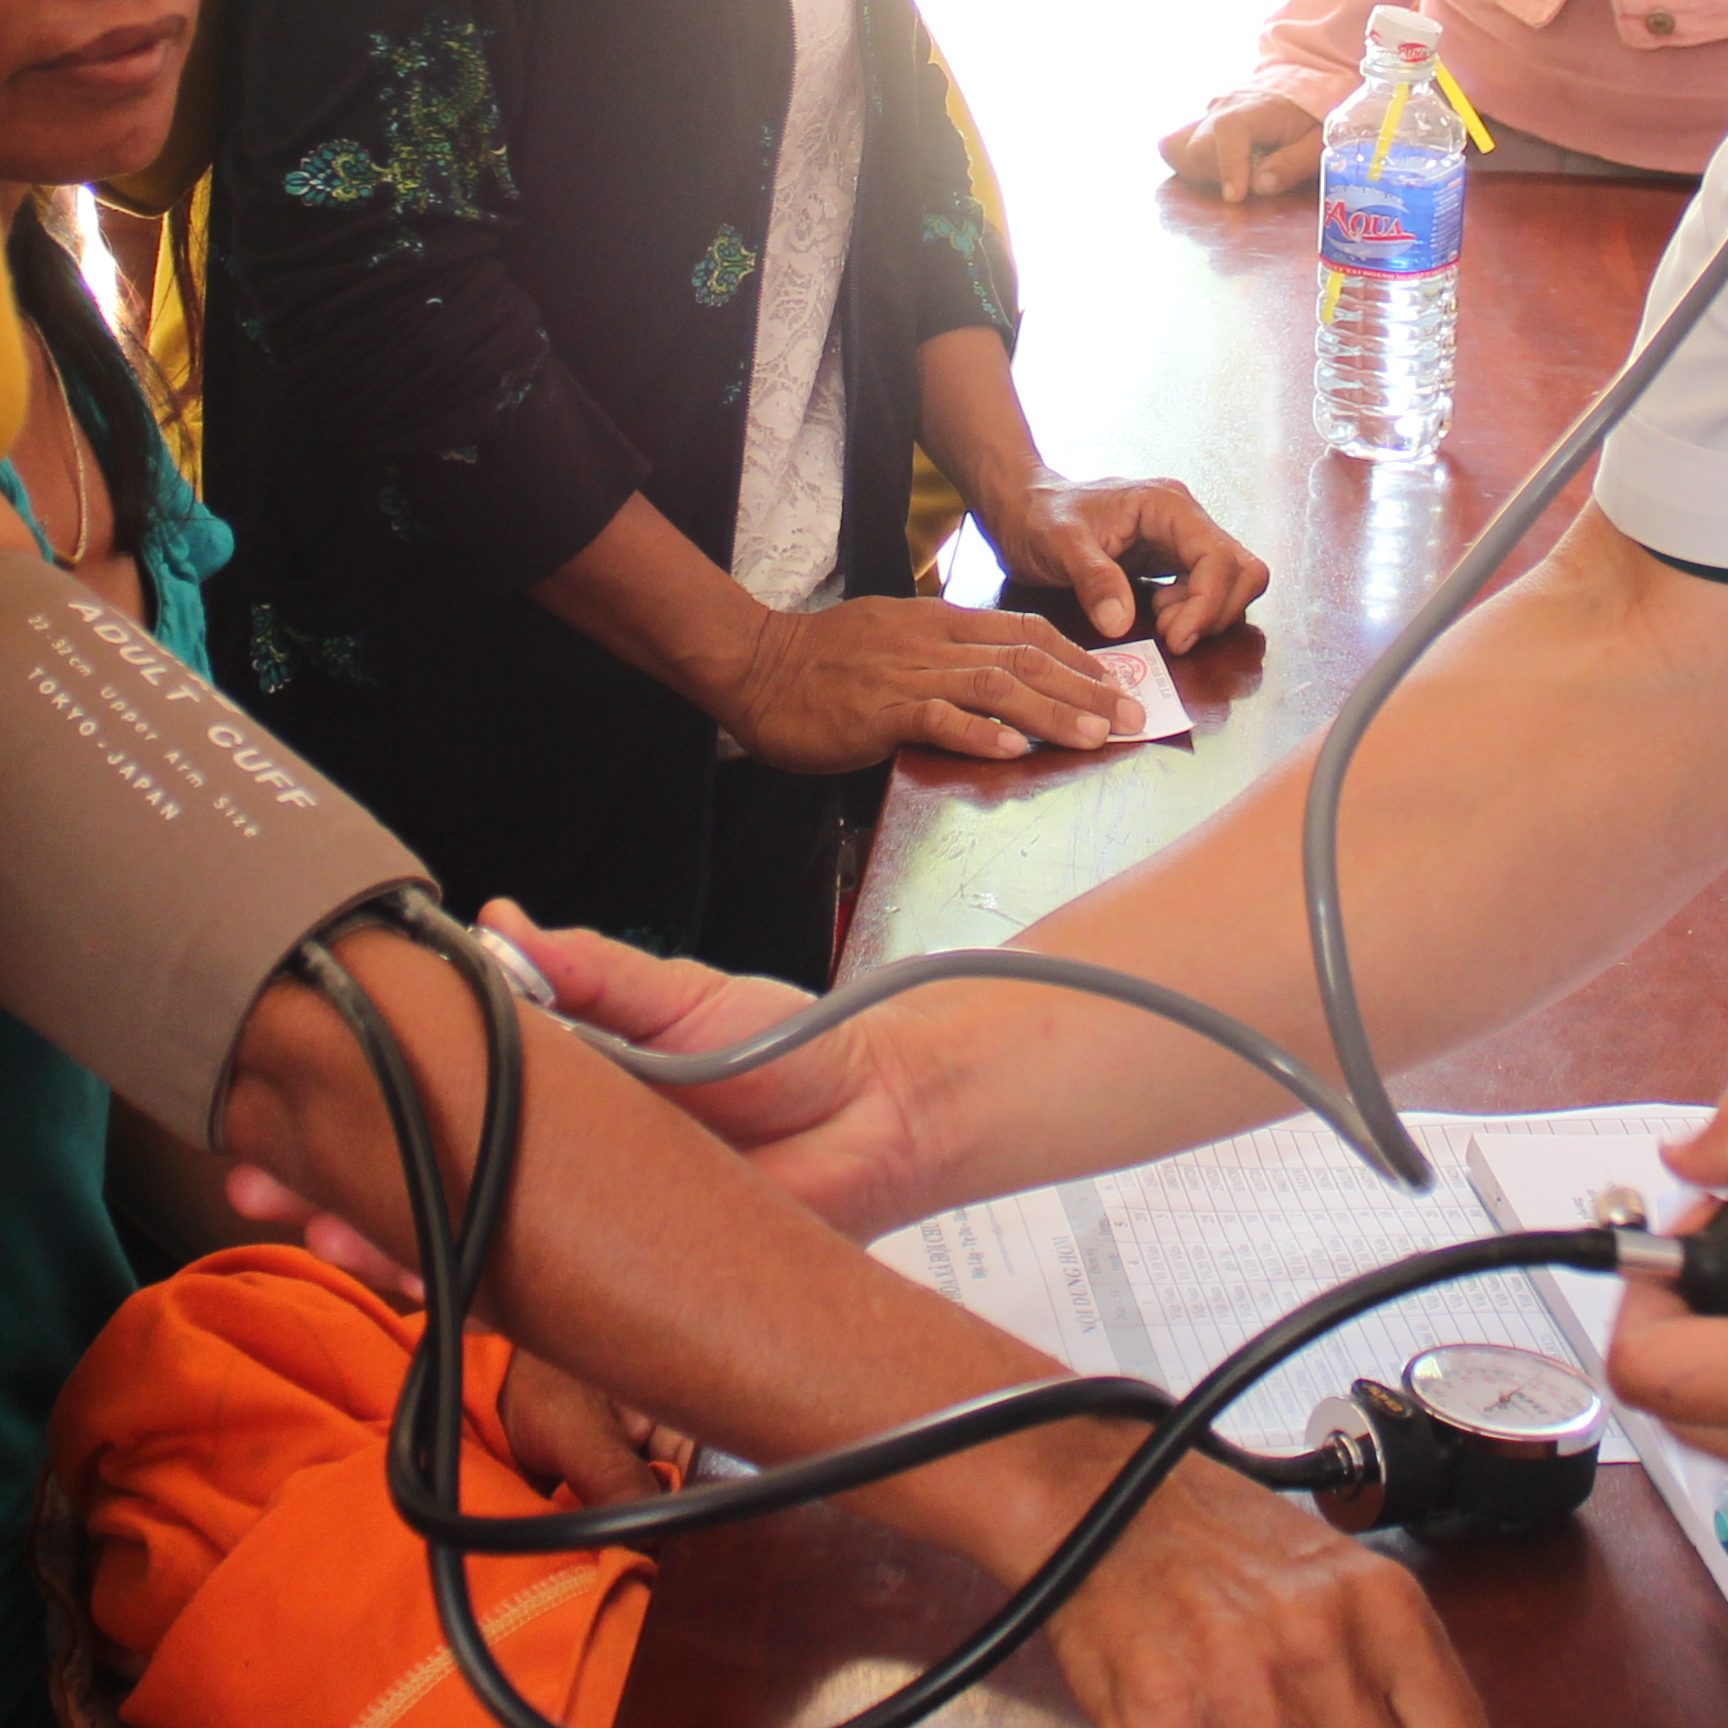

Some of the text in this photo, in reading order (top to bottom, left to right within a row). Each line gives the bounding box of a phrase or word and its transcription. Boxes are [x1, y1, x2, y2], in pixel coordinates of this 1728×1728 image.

[68, 603, 317, 809] ADULT CUFF
[100, 686, 159, 742] Upper
[164, 750, 205, 789] Arm
[213, 797, 260, 839] Size
[1062, 1268, 1092, 1306] DUNG
